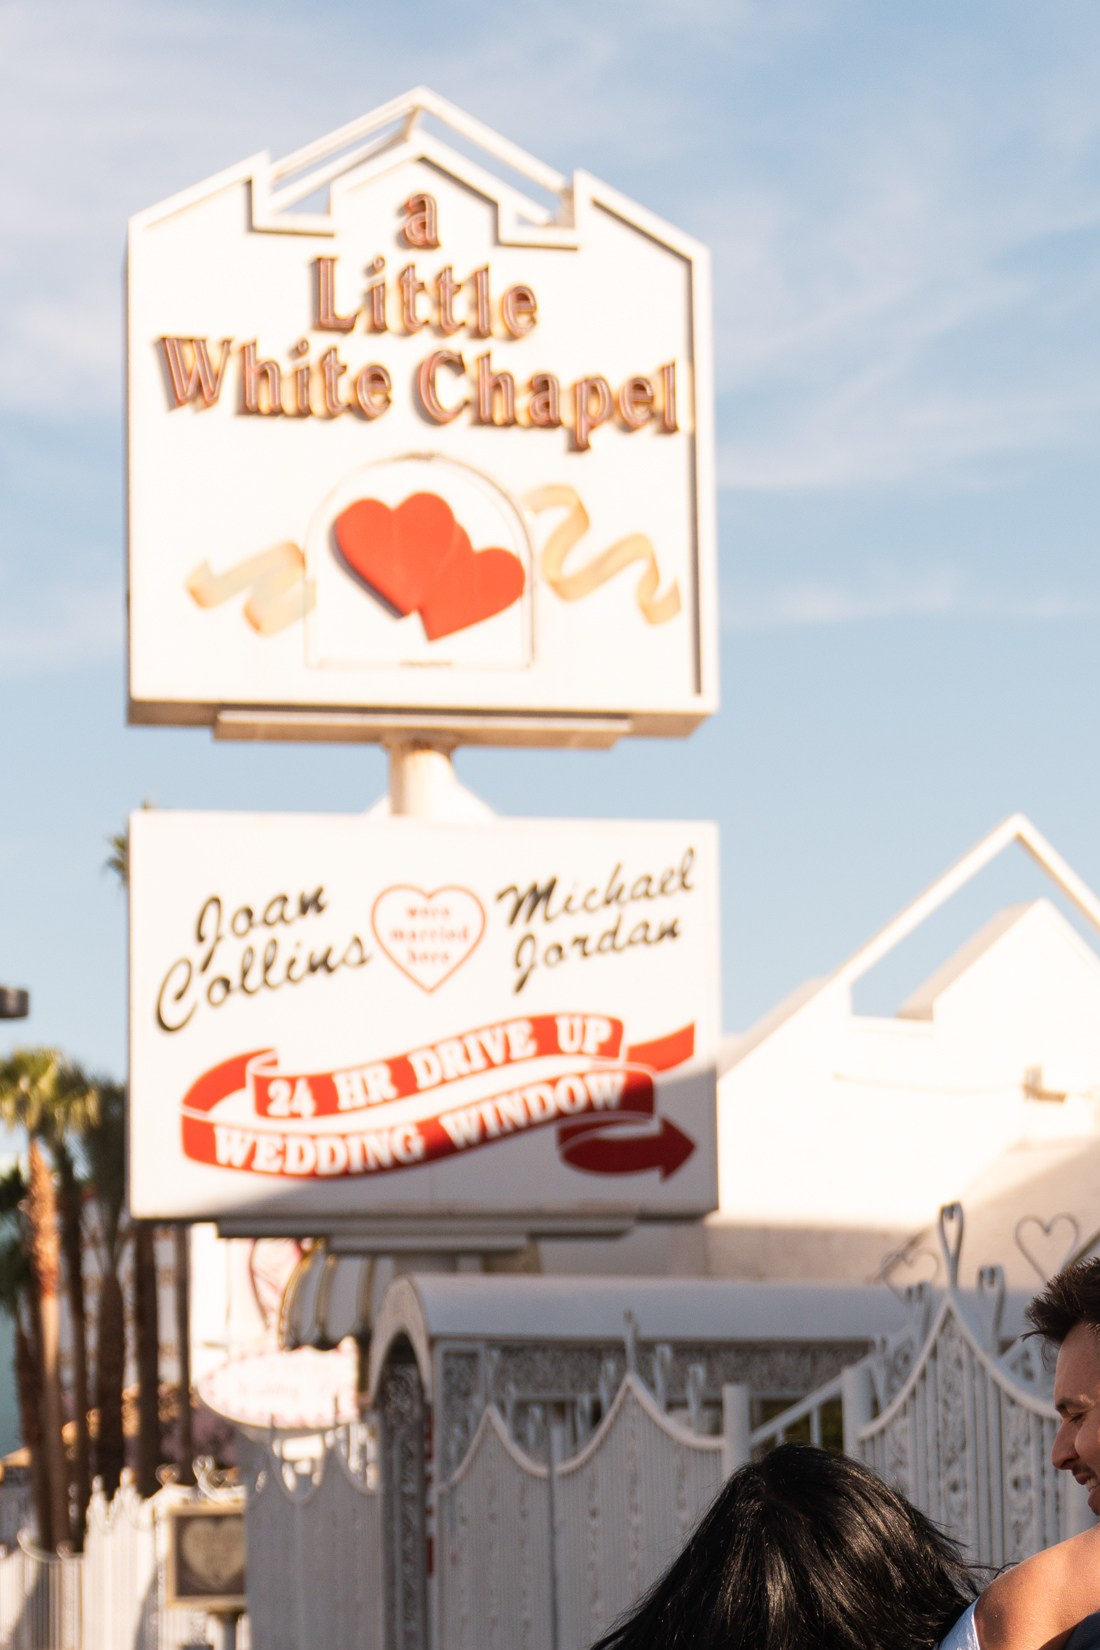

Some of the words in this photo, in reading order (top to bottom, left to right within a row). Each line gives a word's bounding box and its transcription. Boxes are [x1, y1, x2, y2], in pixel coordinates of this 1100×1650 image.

[403, 193, 438, 247] a
[312, 257, 538, 339] Little
[158, 338, 392, 420] White
[417, 350, 678, 451] Chapel
[195, 885, 327, 972] Joan
[496, 846, 696, 924] Michael
[156, 935, 371, 1032] Collins
[513, 911, 681, 995] Jordan
[267, 1076, 315, 1118] 24
[333, 1062, 398, 1112] HR
[407, 1020, 538, 1090] DRIVE
[555, 1015, 612, 1055] UP
[214, 1122, 425, 1176] WEDDING
[439, 1070, 626, 1150] WINDOW
